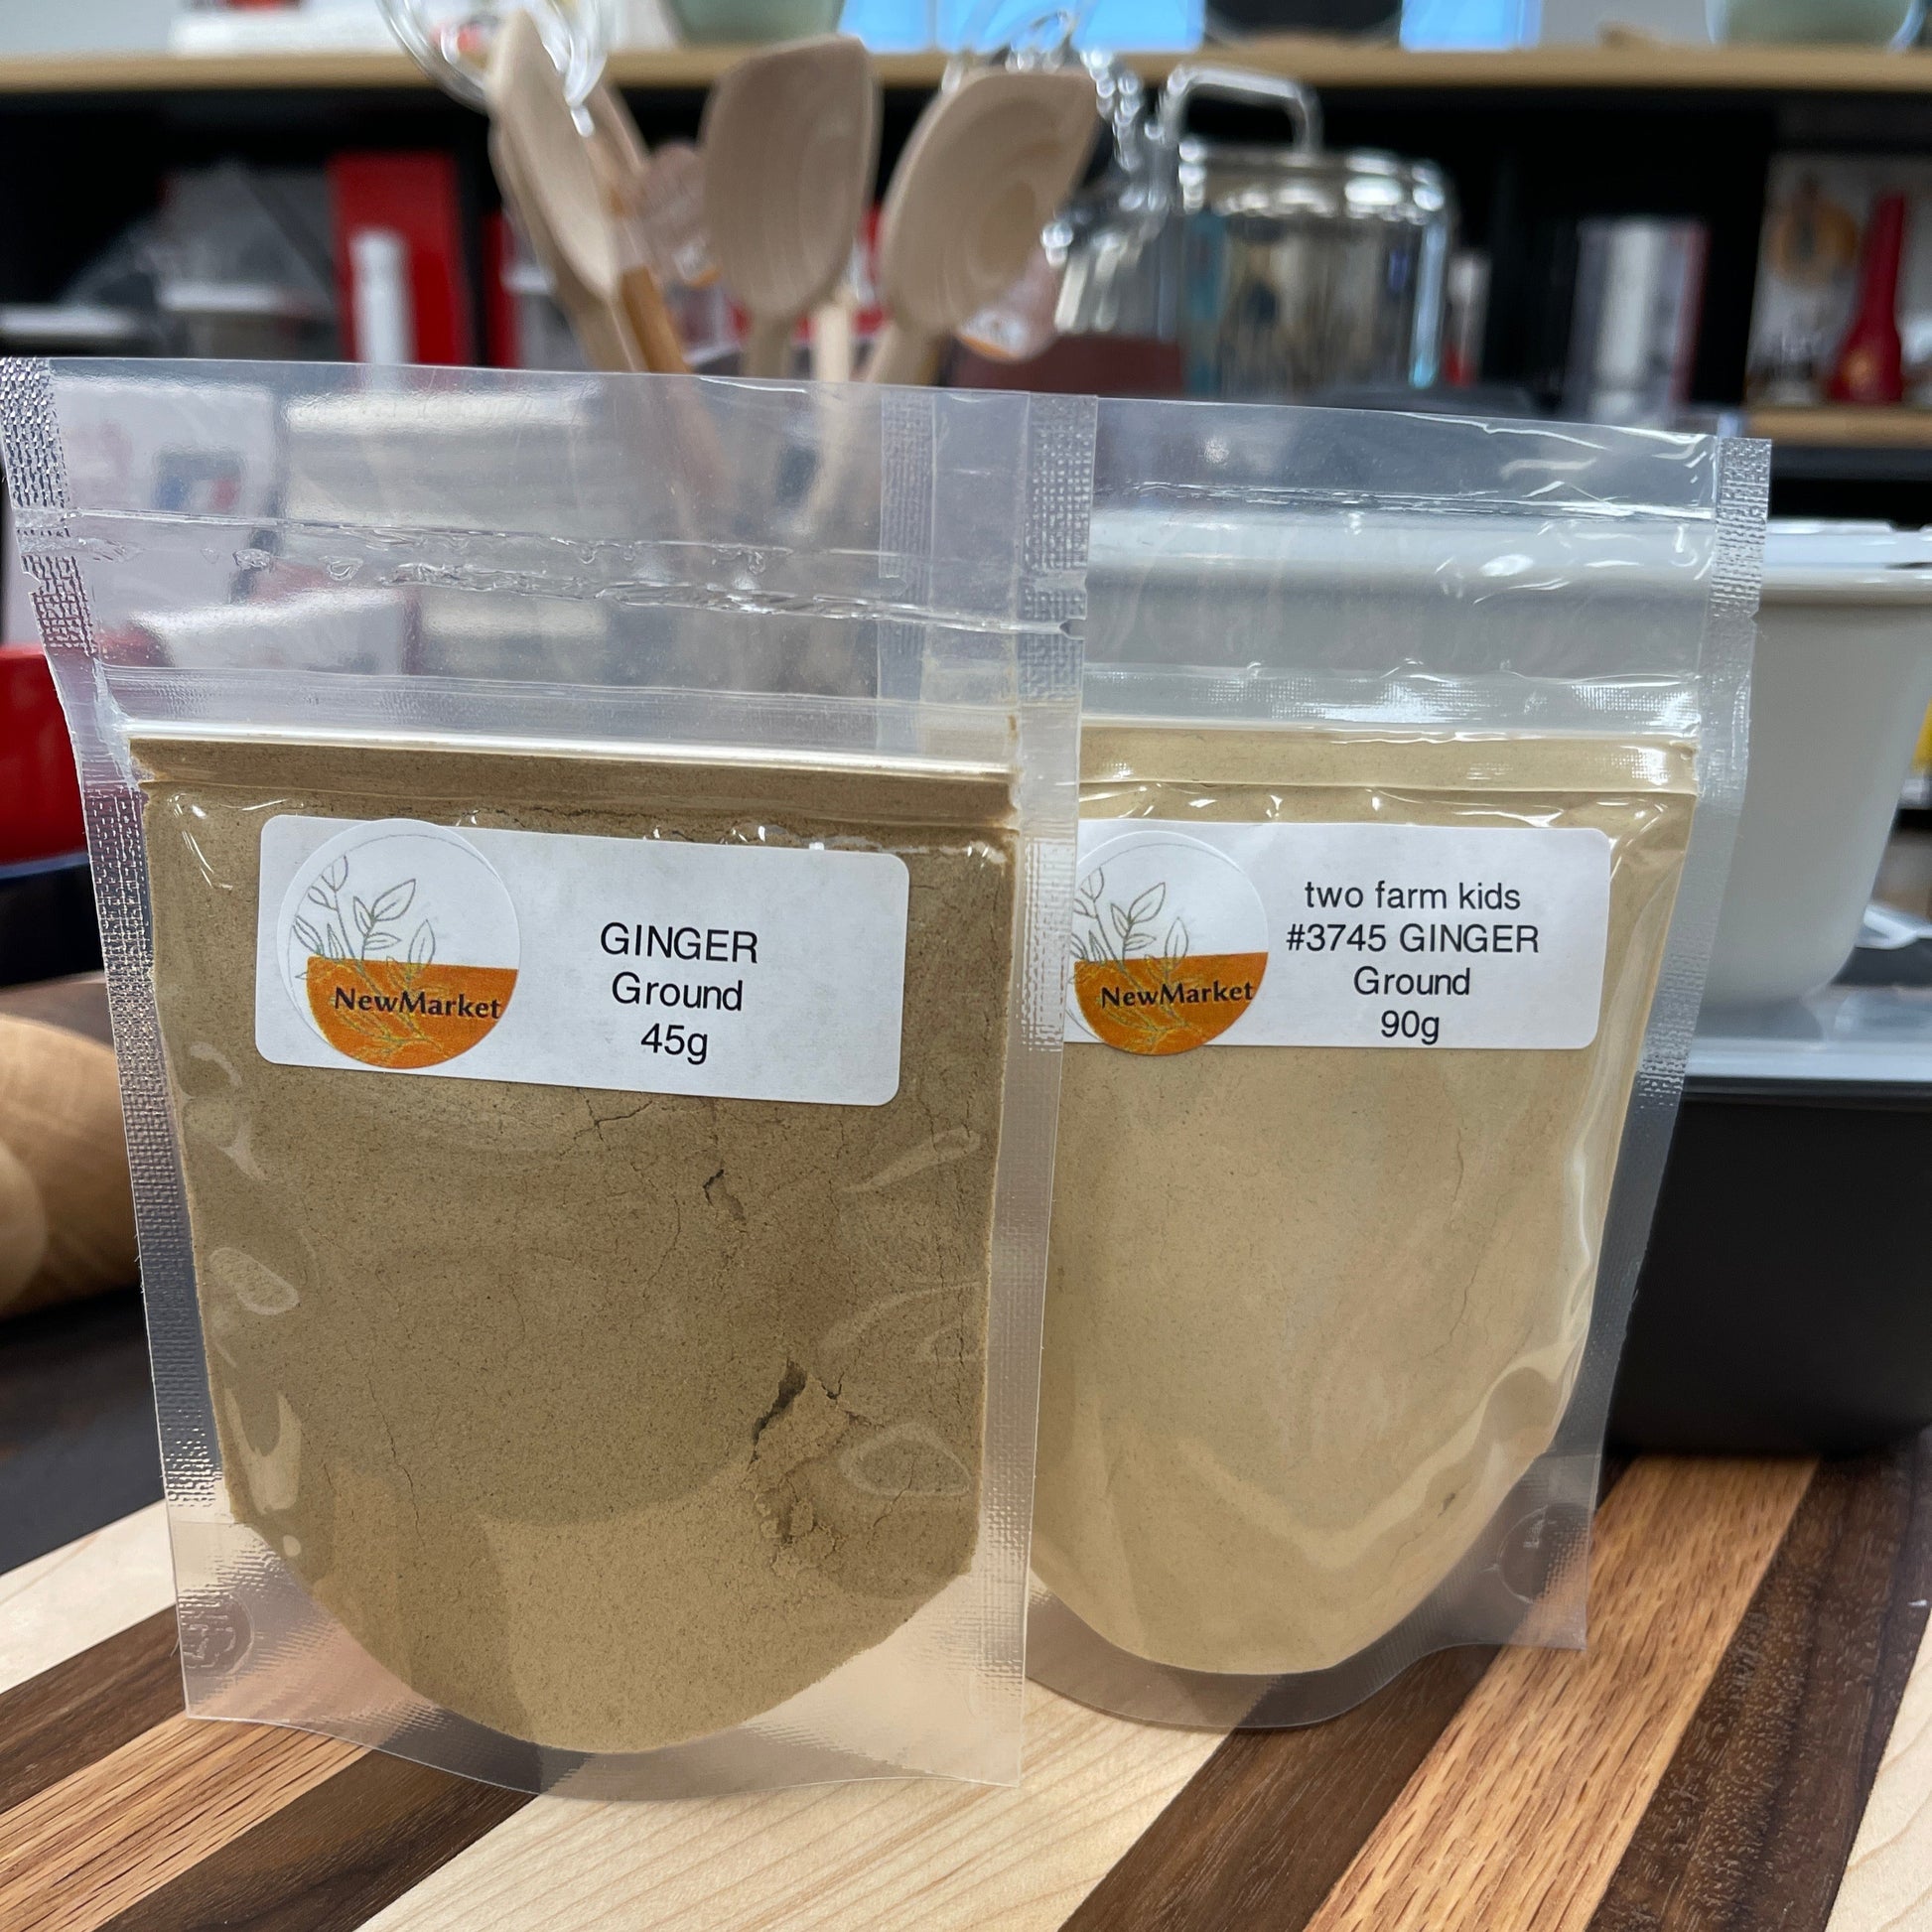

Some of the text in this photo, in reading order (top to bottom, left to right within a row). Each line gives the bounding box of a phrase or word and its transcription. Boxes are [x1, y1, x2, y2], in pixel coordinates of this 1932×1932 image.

[1305, 880, 1521, 910] two farm kids
[600, 921, 758, 964] GINGER
[1286, 922, 1539, 953] #3745 GINGER
[612, 971, 744, 1012] Ground
[1100, 981, 1254, 1009] NewMarket
[1353, 965, 1470, 996] Ground
[333, 987, 501, 1020] NewMarket
[1381, 1010, 1440, 1045] 90g
[640, 1023, 708, 1066] 45g
